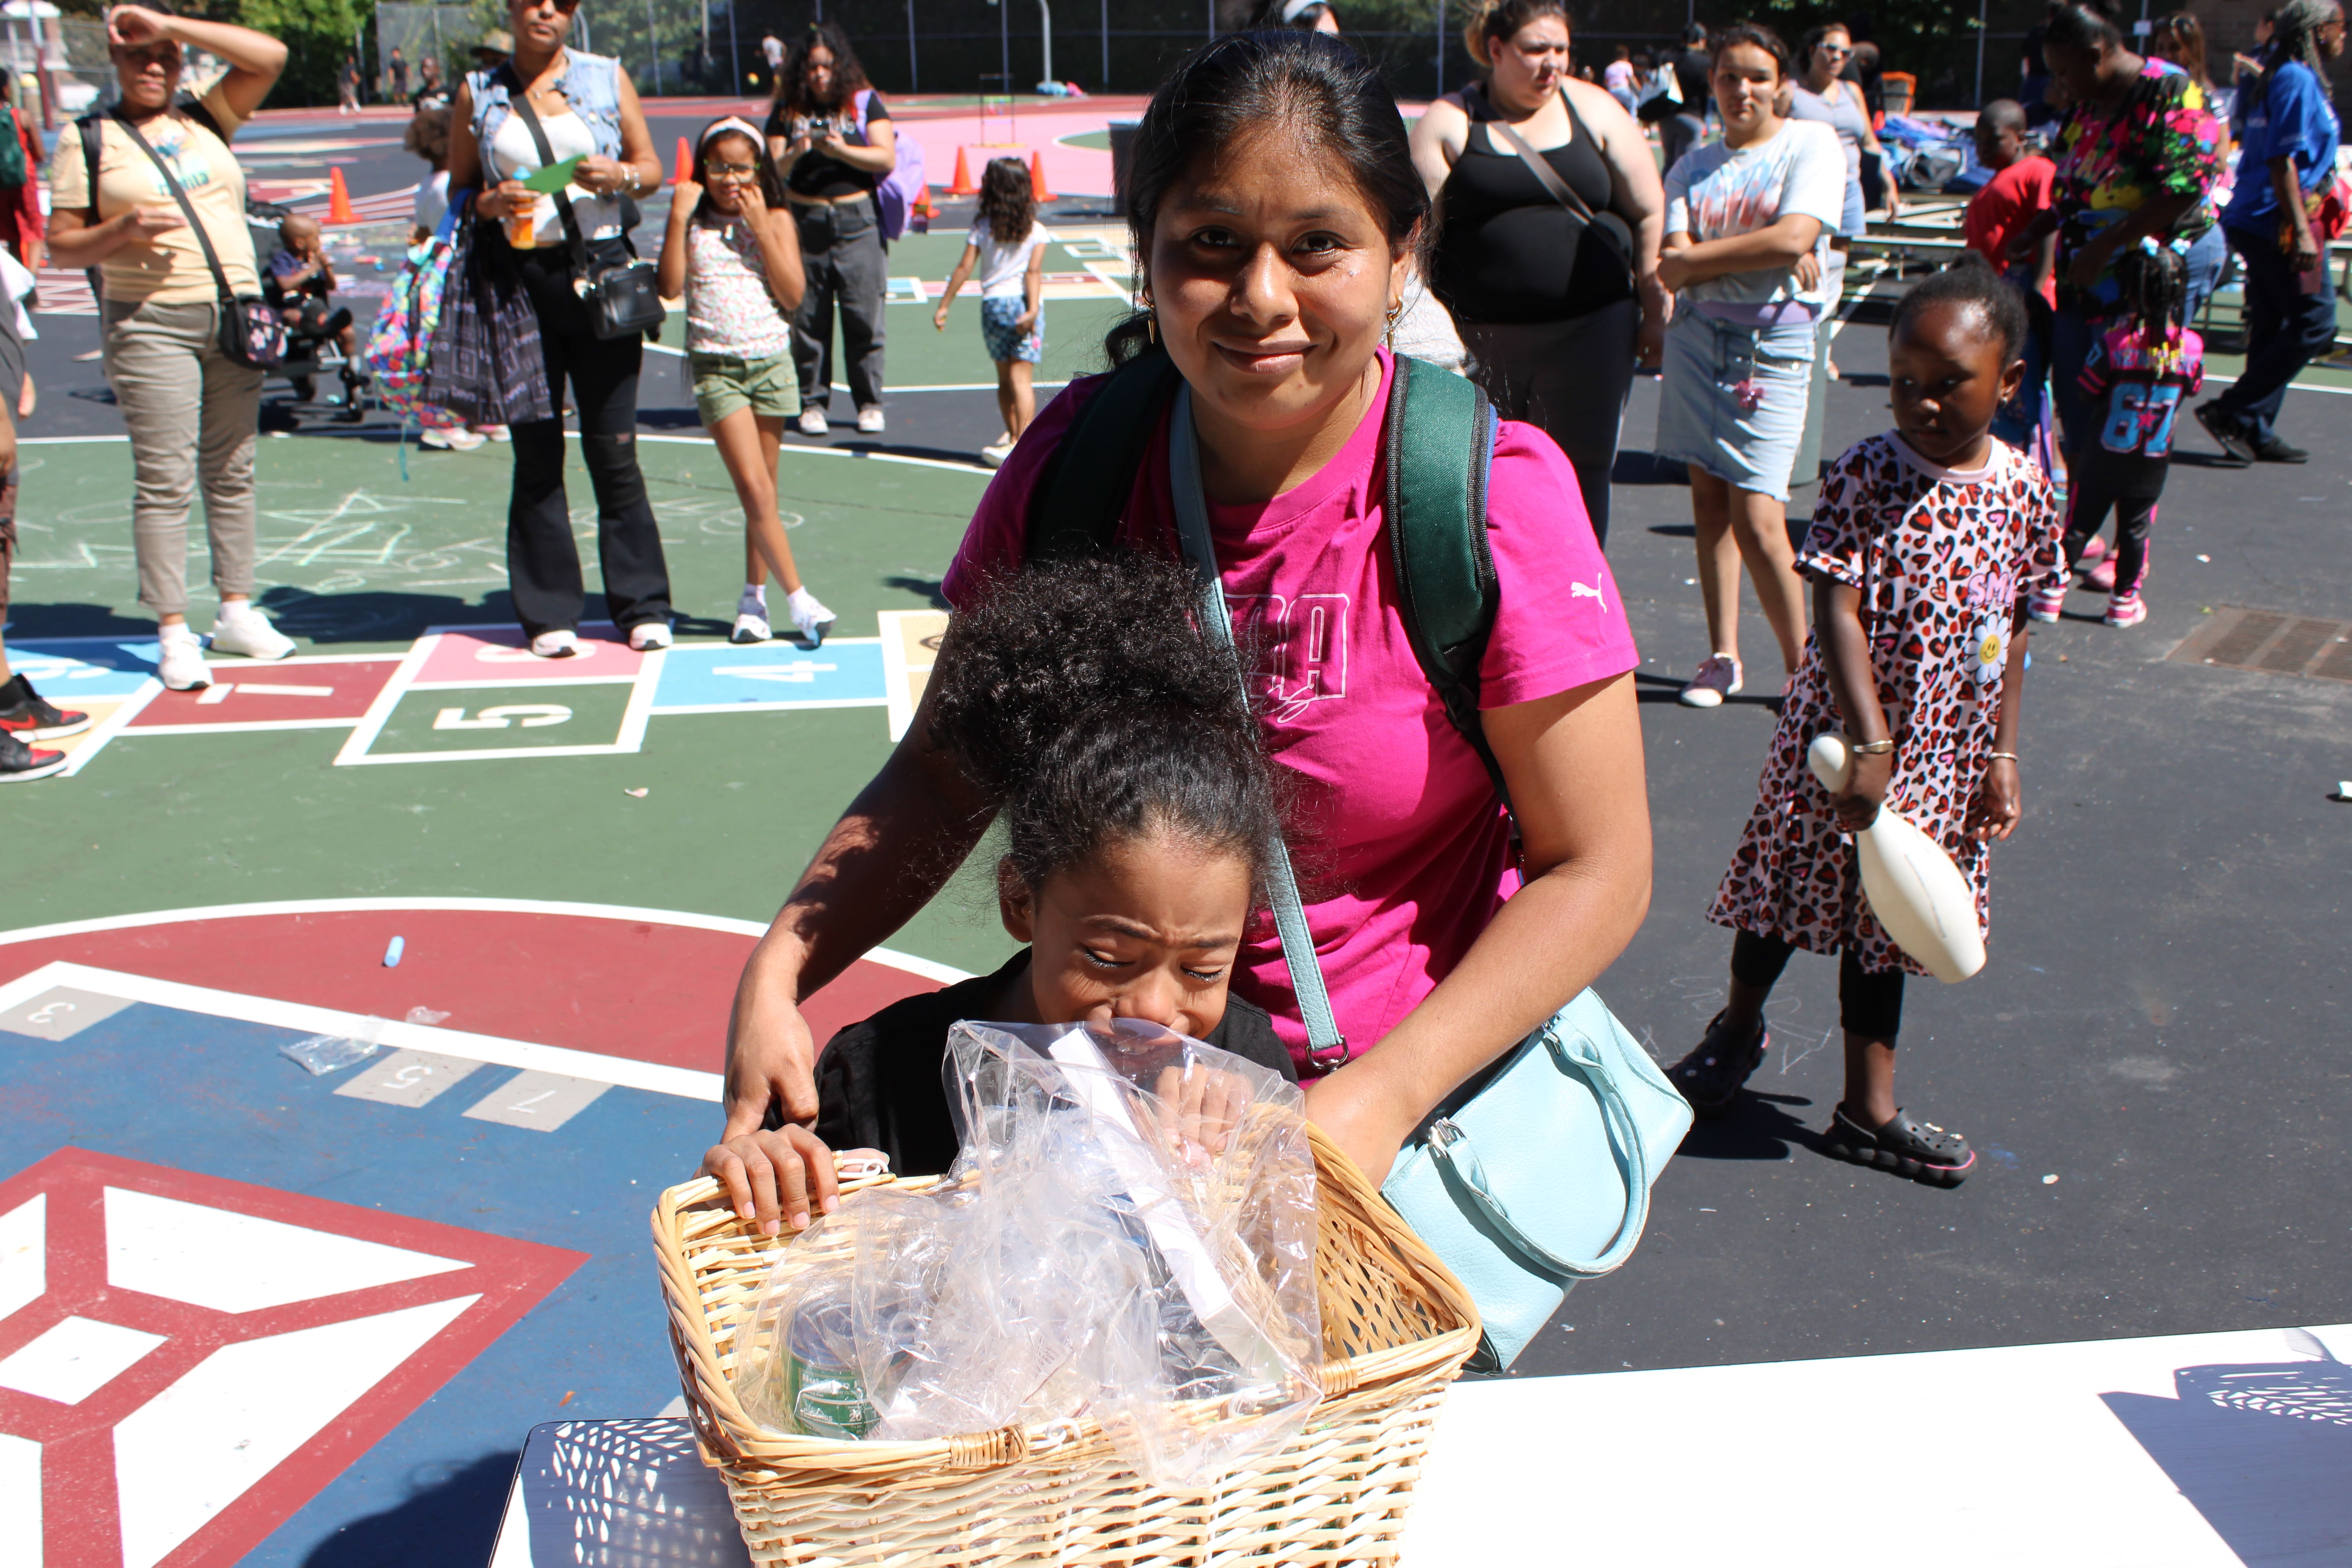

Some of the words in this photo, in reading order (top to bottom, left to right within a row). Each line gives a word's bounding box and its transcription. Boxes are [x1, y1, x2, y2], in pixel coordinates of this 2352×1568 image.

[2101, 379, 2183, 457] 67
[1967, 572, 2017, 611] SMI
[712, 661, 837, 682] 4
[432, 704, 573, 730] 5
[27, 1002, 76, 1024] 3
[382, 1065, 433, 1089] 5
